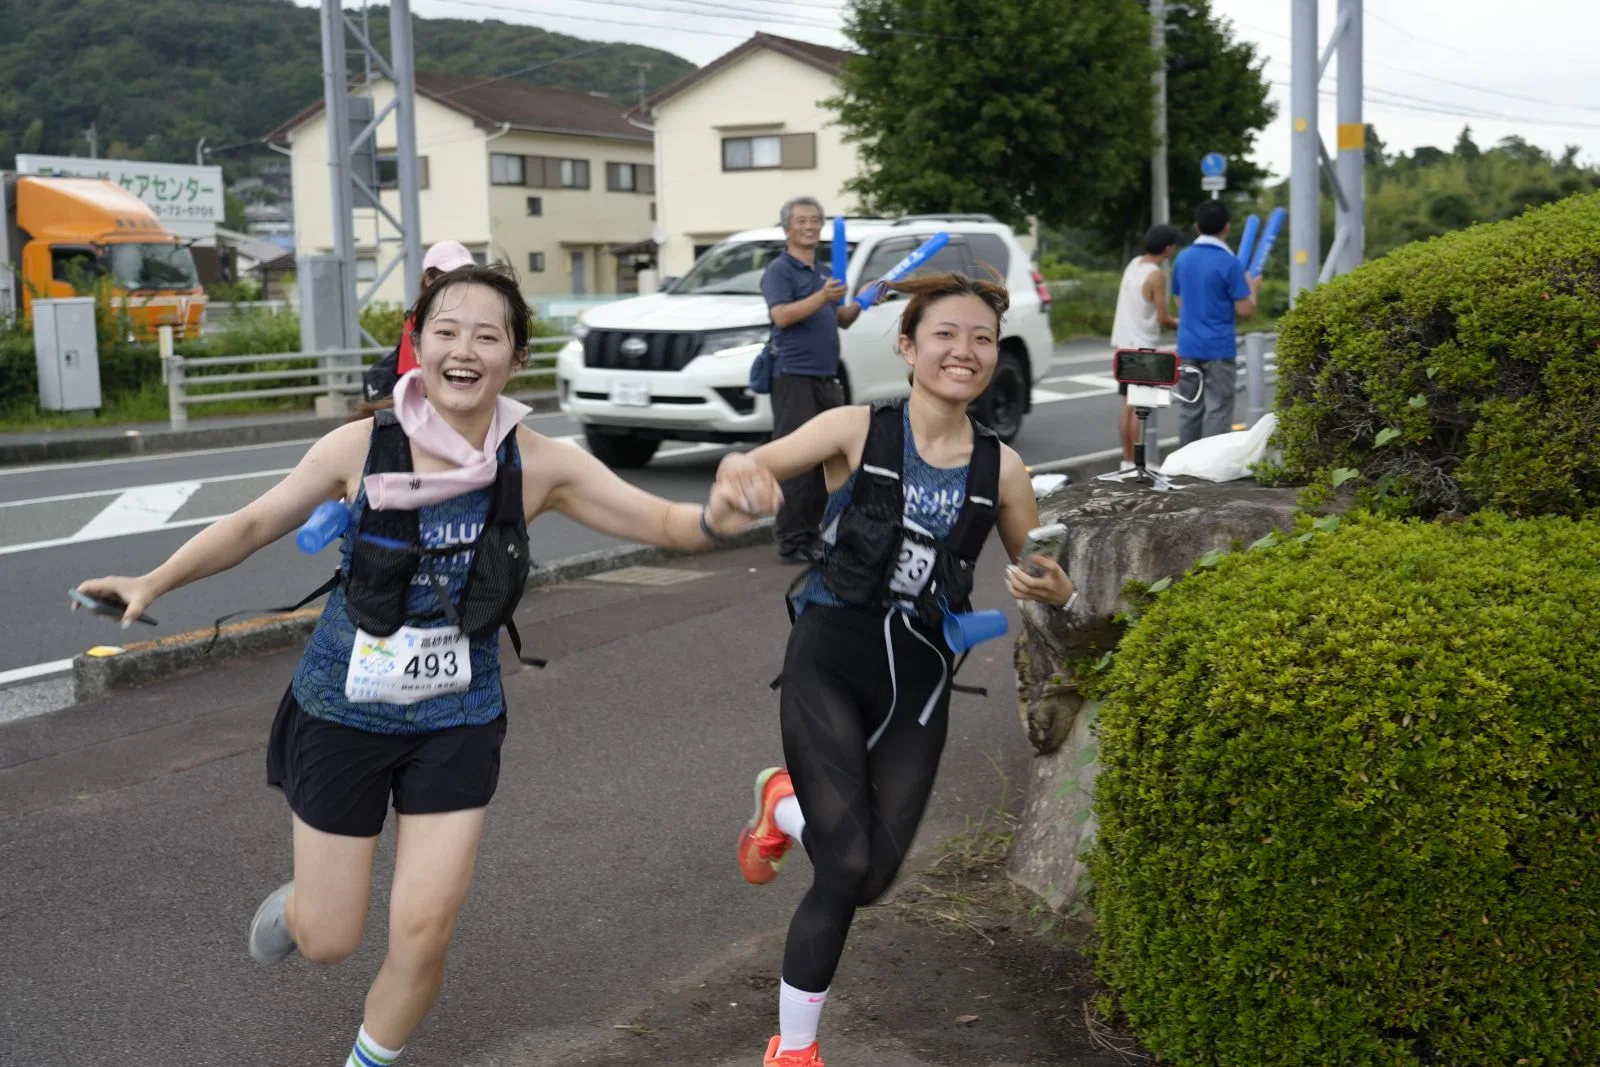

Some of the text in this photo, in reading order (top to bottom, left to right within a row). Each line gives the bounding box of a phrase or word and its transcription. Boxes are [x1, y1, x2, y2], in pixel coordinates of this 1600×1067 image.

[119, 172, 214, 202] ケアセンター
[404, 650, 458, 679] 493
